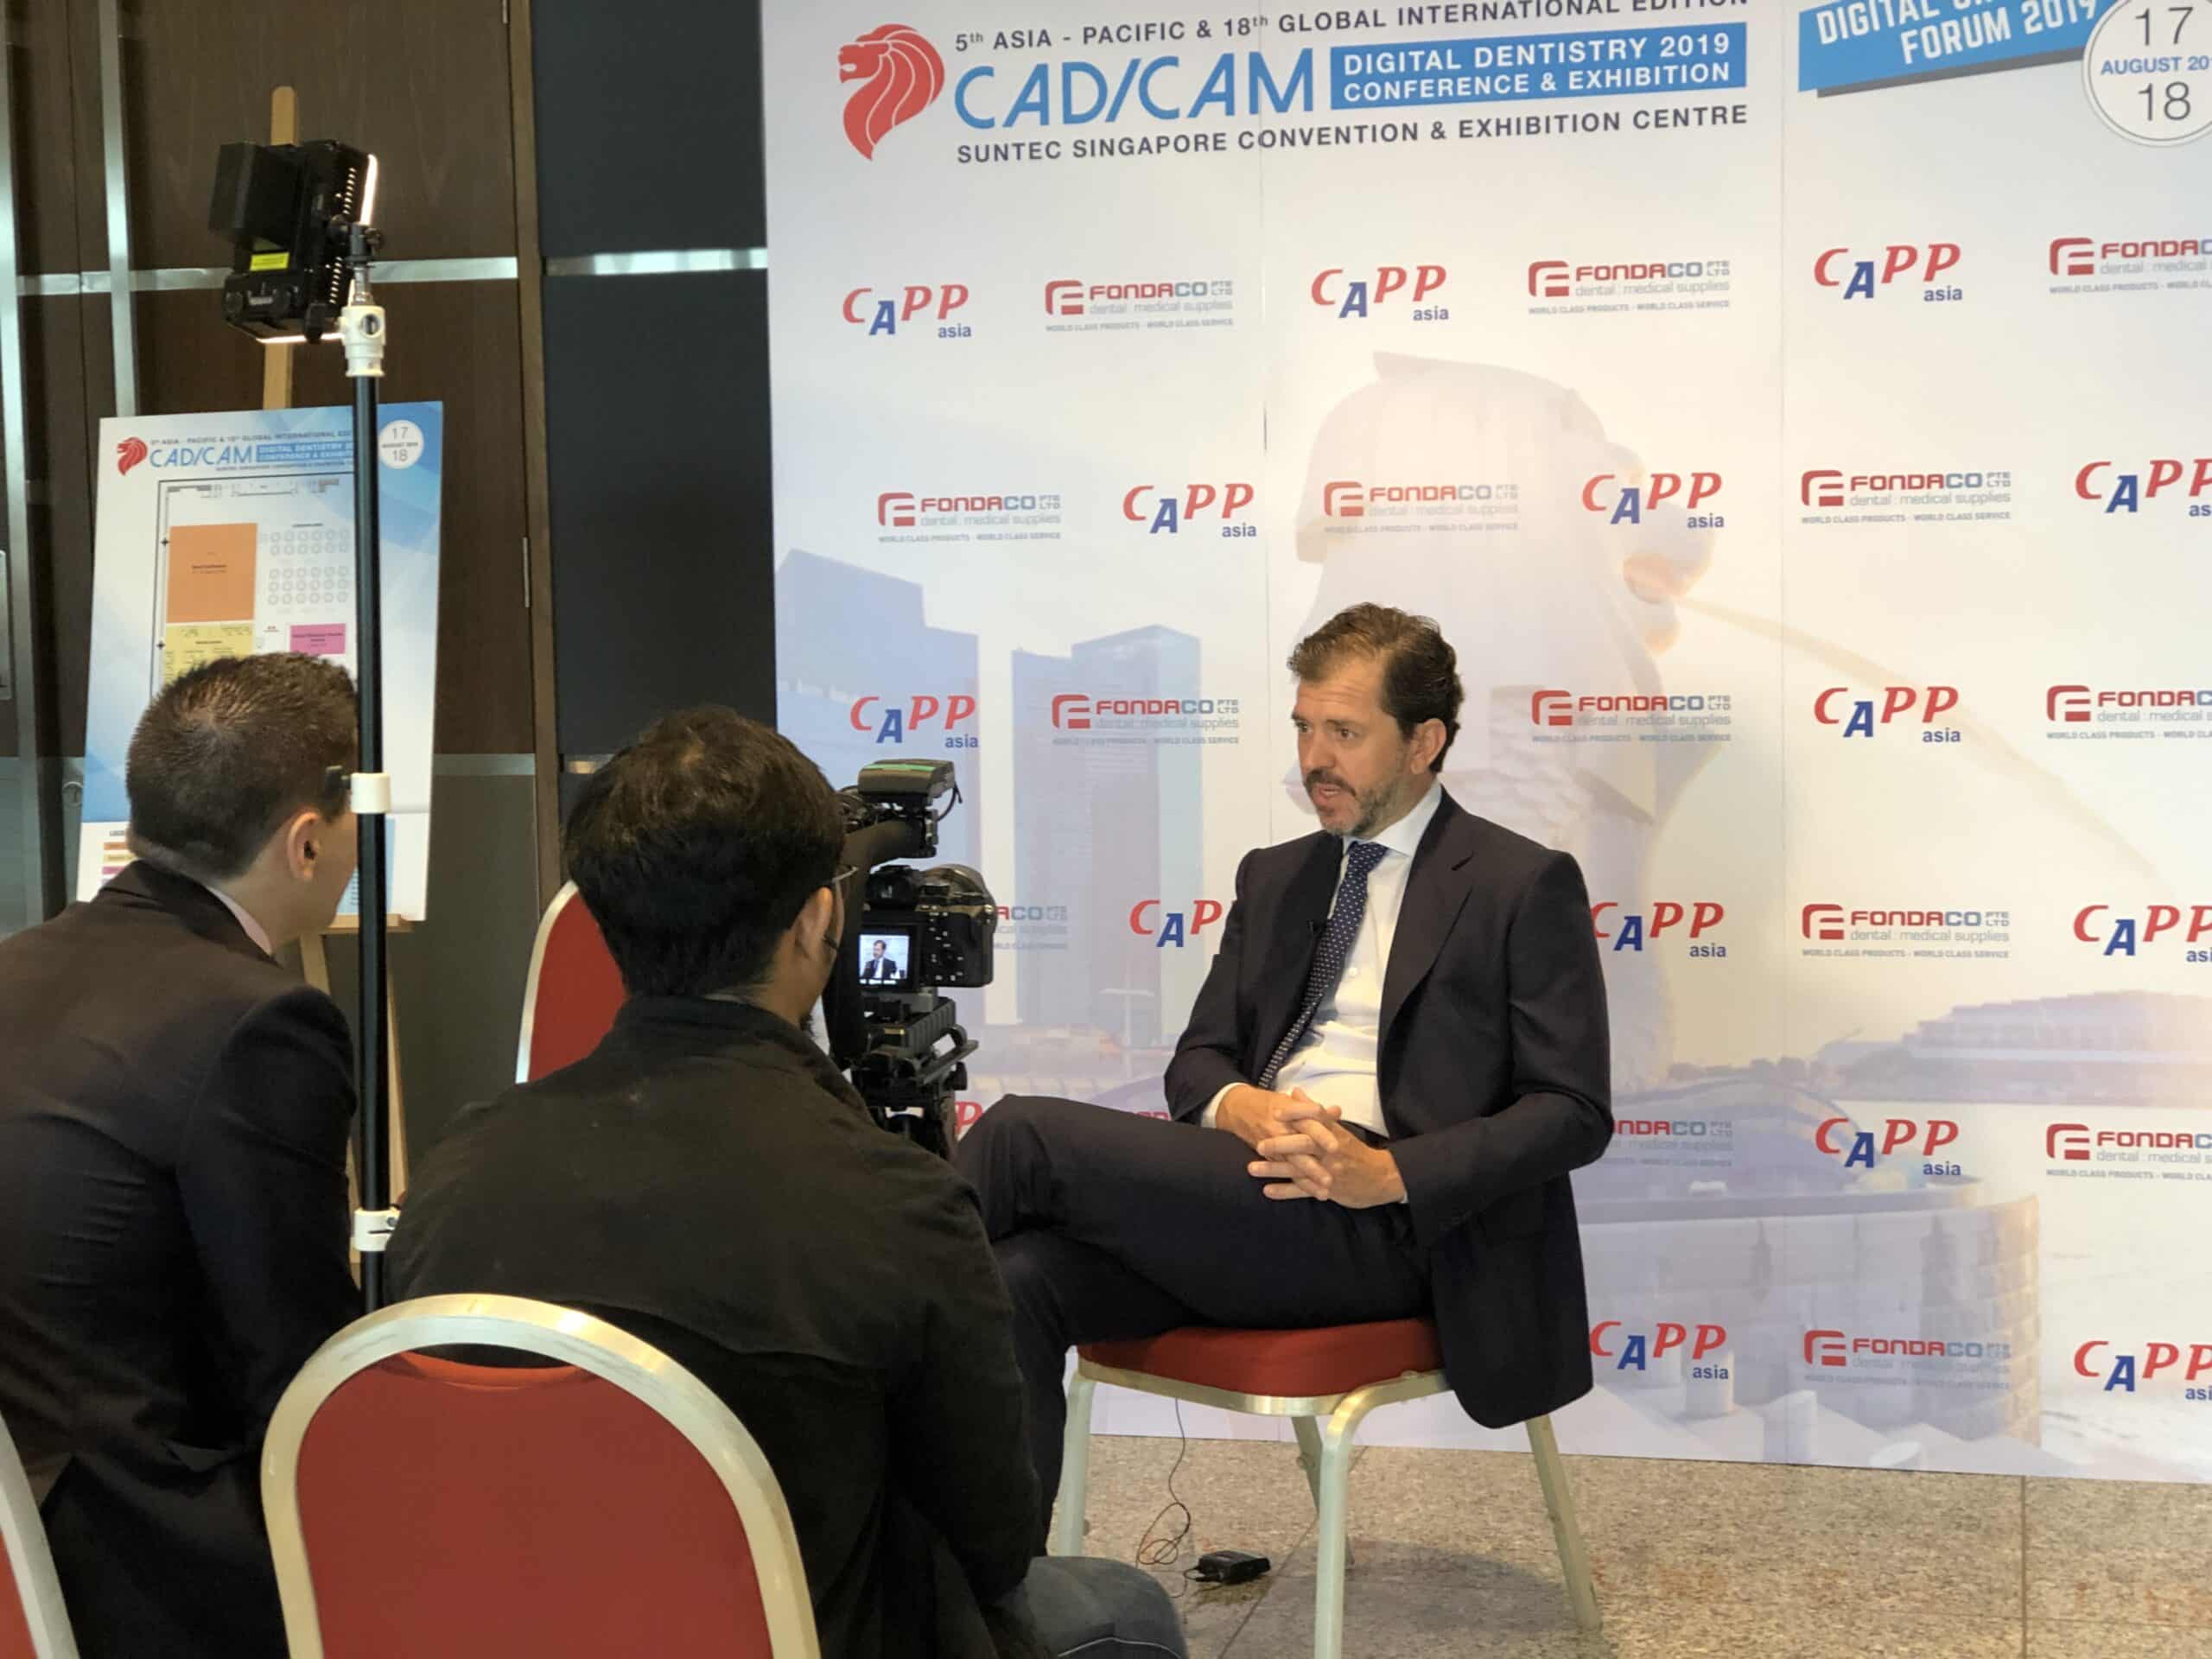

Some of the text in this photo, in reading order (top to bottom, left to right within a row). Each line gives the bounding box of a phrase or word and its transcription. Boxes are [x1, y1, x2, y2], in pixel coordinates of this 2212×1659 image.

[993, 29, 1052, 49] ASIA
[1083, 22, 1185, 46] PACIFIC
[1197, 20, 1212, 39] &
[1280, 10, 1386, 33] GLOBAL
[1398, 0, 1620, 27] INTERNATIONAL
[1816, 0, 1940, 44] DIGITAL
[2135, 7, 2193, 46] 17
[1901, 0, 2096, 65] FORUM 2019
[1344, 33, 1730, 76] DIGITAL DENTISTRY 2019
[2101, 57, 2182, 75] AUGUST
[954, 48, 1313, 130] CAD/CAM
[1344, 61, 1730, 102] CONFERENCE & EXHIBITION
[2138, 81, 2191, 121] 18
[957, 104, 1747, 163] SUNTEC SINGAPORE CONVENTION & EXHIBITION CENTRE
[2101, 239, 2212, 259] FONDAC
[1576, 263, 1703, 282] FONDACO
[1815, 244, 1961, 300] CAPP
[1090, 282, 1208, 301] FONDACO
[1312, 265, 1446, 319] CAPP
[1923, 285, 1962, 301] asia
[843, 283, 969, 336] CAPP
[1413, 305, 1448, 321] asia
[938, 324, 971, 338] asia
[392, 426, 408, 440] 17
[150, 445, 251, 467] CAD/CAM
[393, 448, 408, 461] 18
[1851, 474, 1983, 491] FONDACO
[2075, 459, 2212, 513] CAPP
[1370, 485, 1491, 502] FONDACO
[1582, 473, 1722, 524] CAPP
[1850, 491, 2011, 506] dental medical supplies
[921, 496, 1036, 512] FONDACO
[1123, 484, 1255, 534] CAPP
[2189, 504, 2212, 517] as
[1222, 523, 1256, 537] asia
[1688, 512, 1724, 529] asia
[1096, 700, 1214, 715] FONDACO
[1579, 696, 1704, 711] FONDACO
[2098, 690, 2212, 707] FONDAC
[850, 696, 976, 743] CAPP
[1815, 686, 1959, 738] CAPP
[945, 734, 978, 749] asia
[1923, 728, 1961, 743] asia
[1129, 899, 1224, 947] CAP
[1590, 902, 1724, 951] CAPP
[1851, 912, 1981, 926] FONDACO
[1851, 929, 2009, 944] dental medical supplies
[2074, 905, 2212, 956] CAPP
[1689, 943, 1726, 957] asia
[1615, 1120, 1706, 1135] NDACO
[1815, 1118, 1959, 1168] CAPP
[2097, 1131, 2212, 1148] FONDAC
[2097, 1150, 2201, 1163] dental medical
[1923, 1160, 1961, 1176] asia
[1590, 1321, 1726, 1370] CAPP
[1853, 1338, 1983, 1357] FONDACO
[1693, 1364, 1728, 1379] asia
[2074, 1341, 2212, 1392] CAPP
